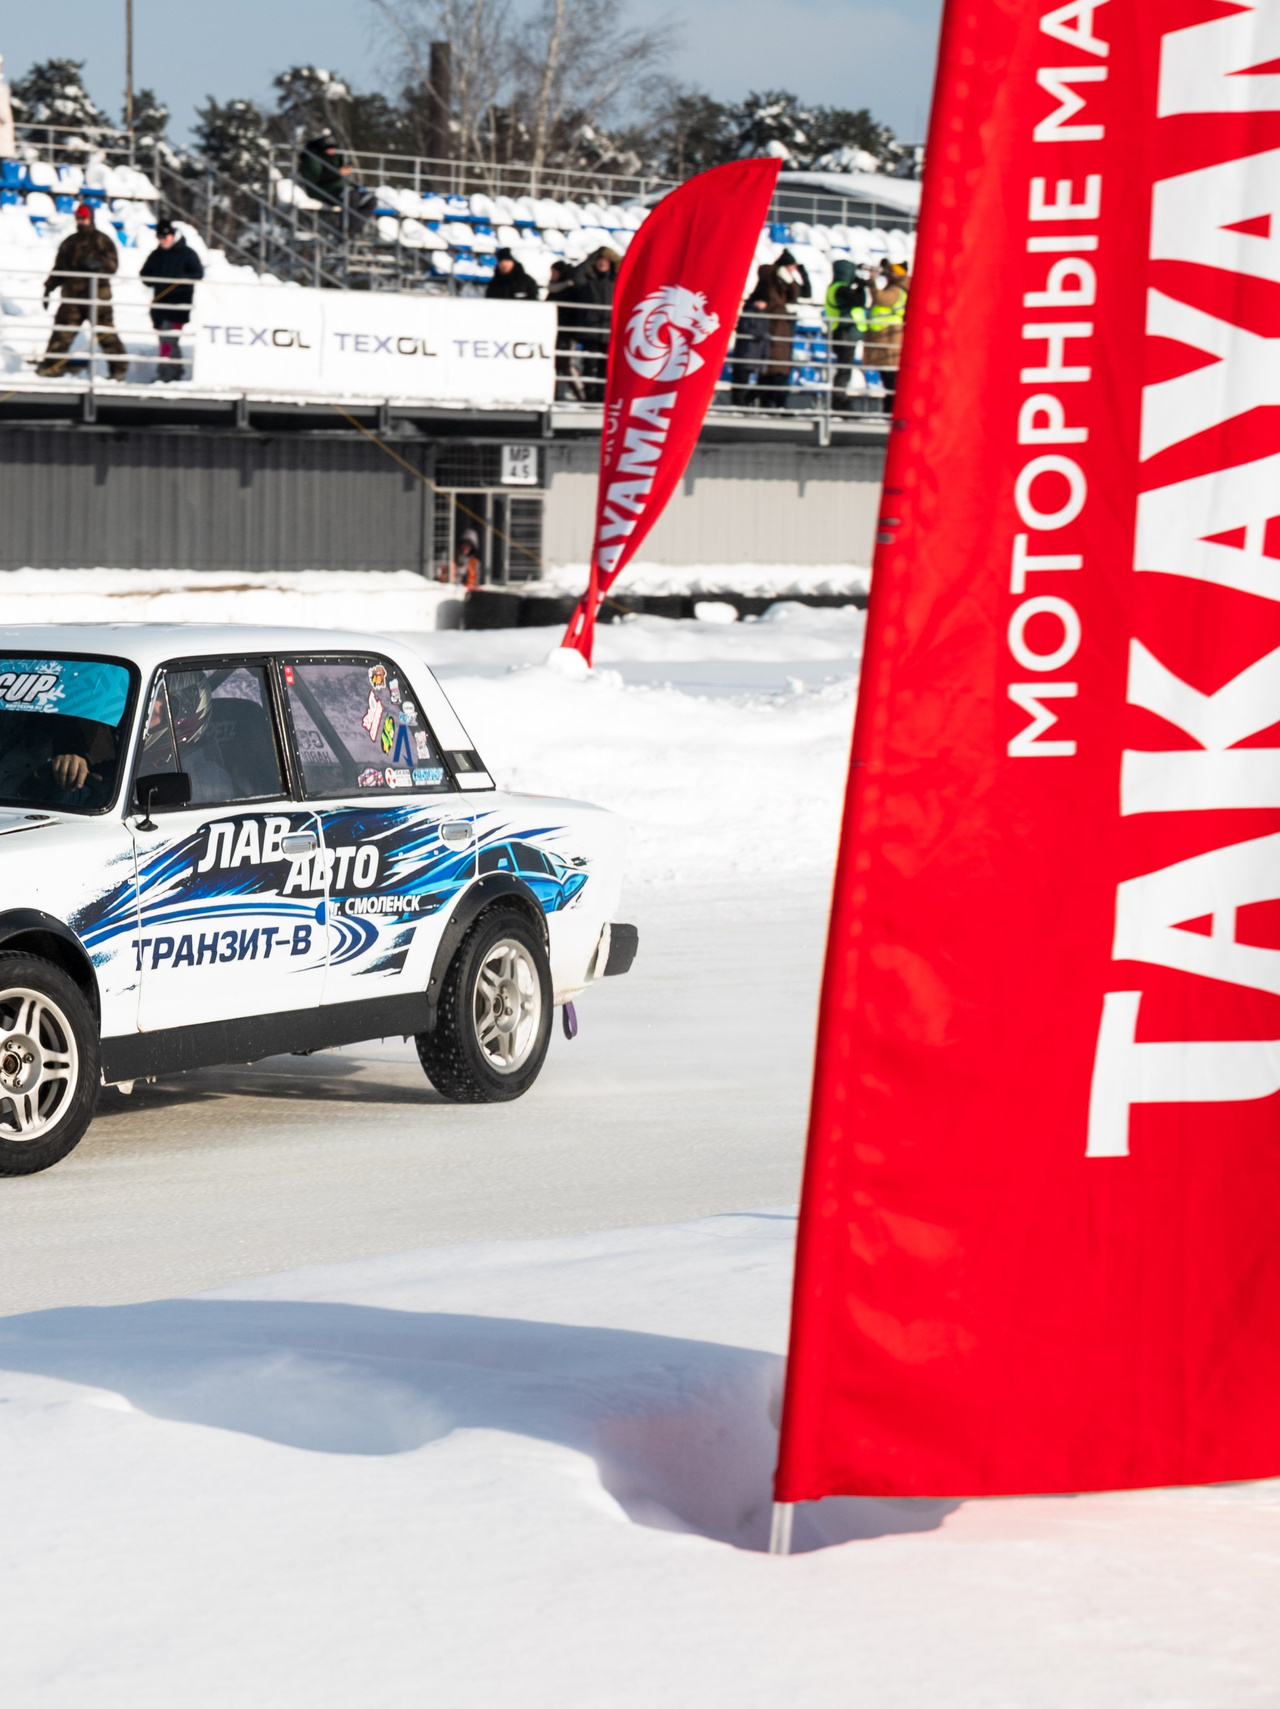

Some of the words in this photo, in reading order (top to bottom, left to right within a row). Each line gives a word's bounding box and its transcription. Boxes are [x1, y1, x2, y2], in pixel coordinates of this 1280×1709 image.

[203, 325, 311, 349] TEXOL
[333, 332, 437, 356] TEXOL
[453, 340, 551, 359] TEXOL
[1007, 174, 1102, 758] МОТОРНЫЕ
[197, 817, 292, 872] ЛАВ
[282, 845, 379, 895] АВТО
[345, 895, 421, 915] СМОЛЕНСК
[132, 924, 312, 971] ТРАНЗИТ-В
